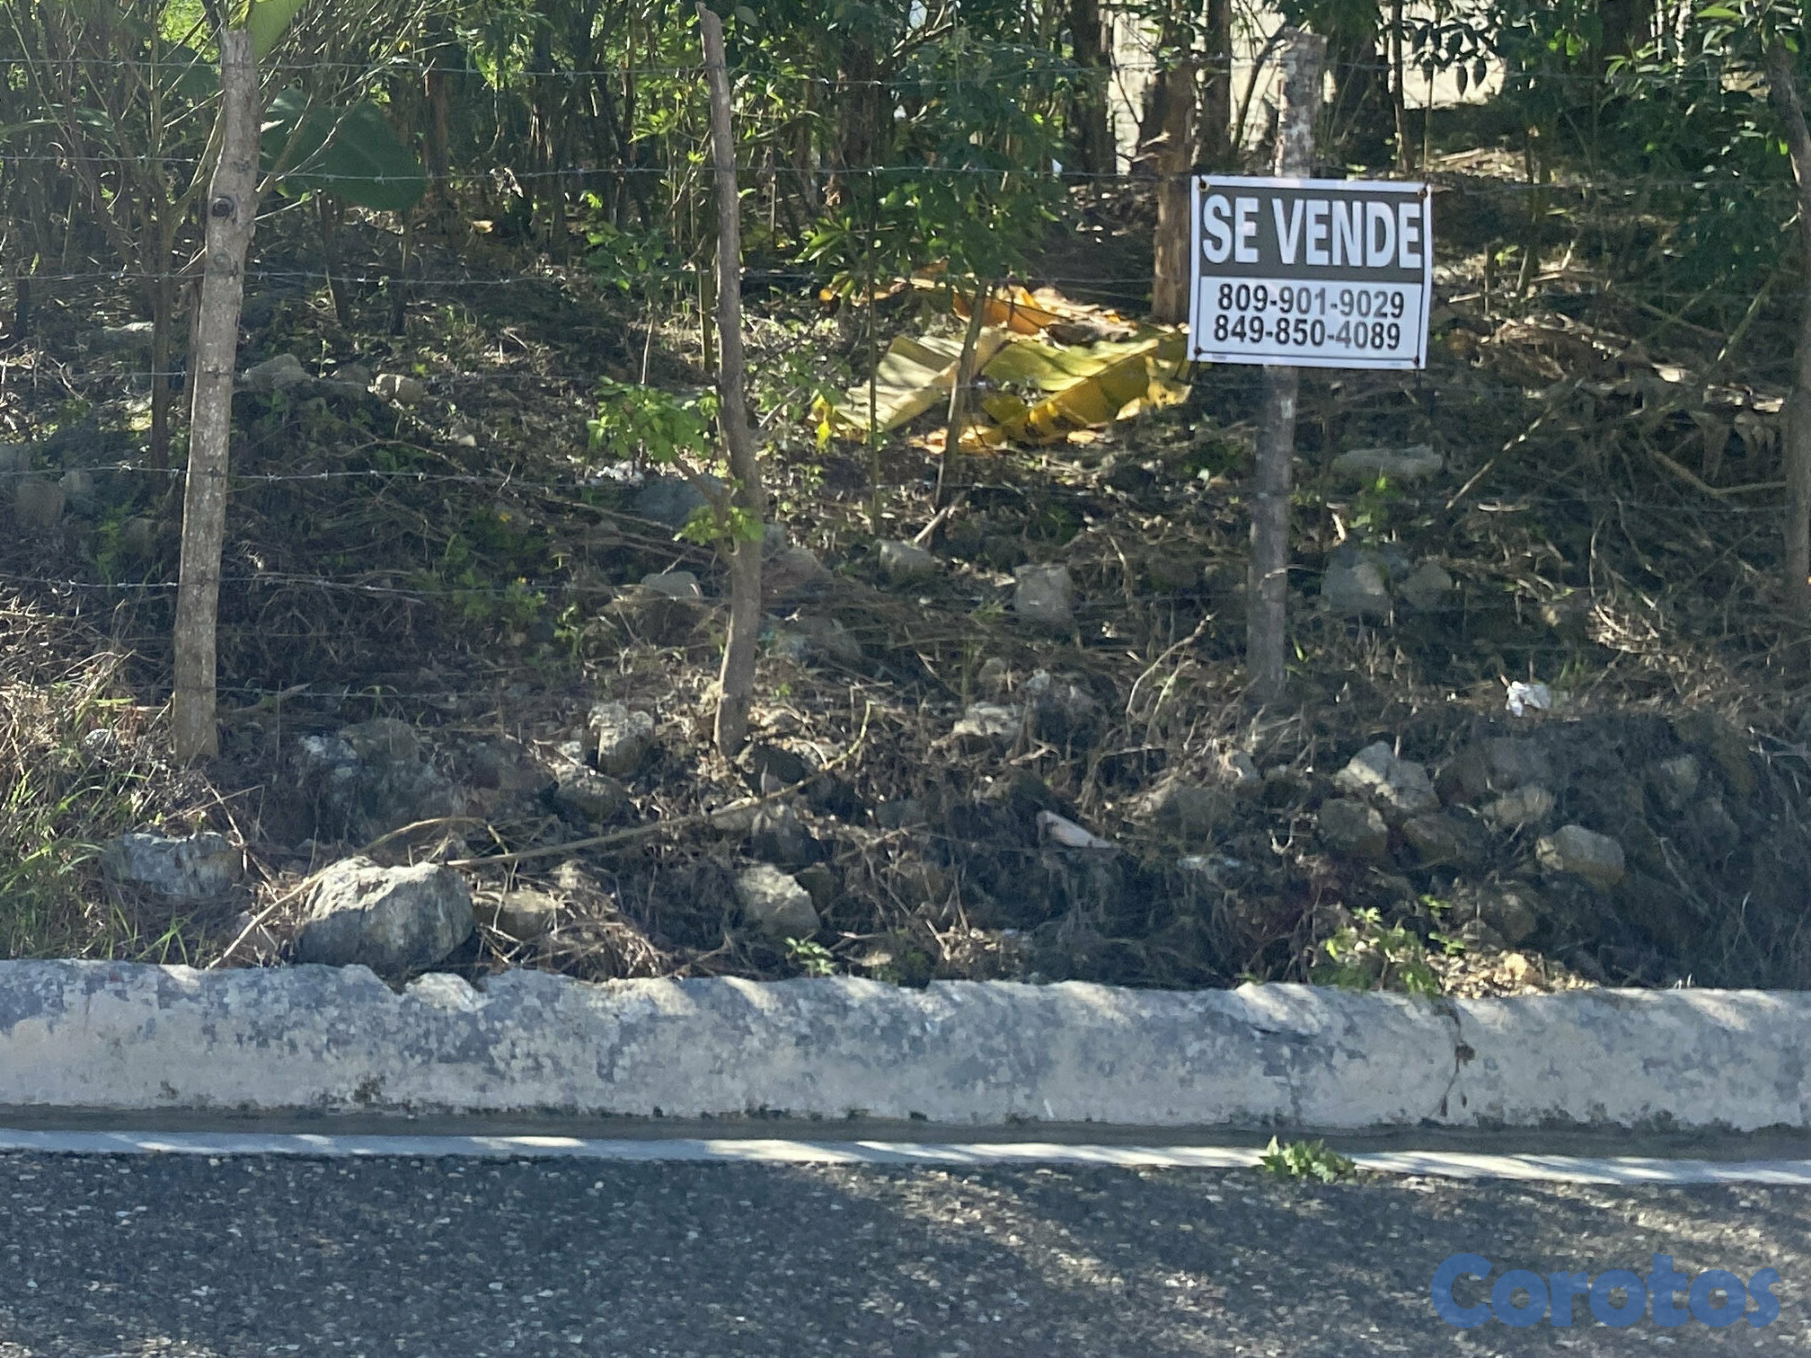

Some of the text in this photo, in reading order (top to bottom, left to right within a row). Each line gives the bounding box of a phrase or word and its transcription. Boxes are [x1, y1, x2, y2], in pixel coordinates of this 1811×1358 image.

[1202, 194, 1422, 269] SE VENDE
[1218, 283, 1405, 319] 809-901-9029
[1214, 315, 1401, 350] 849-850-4089
